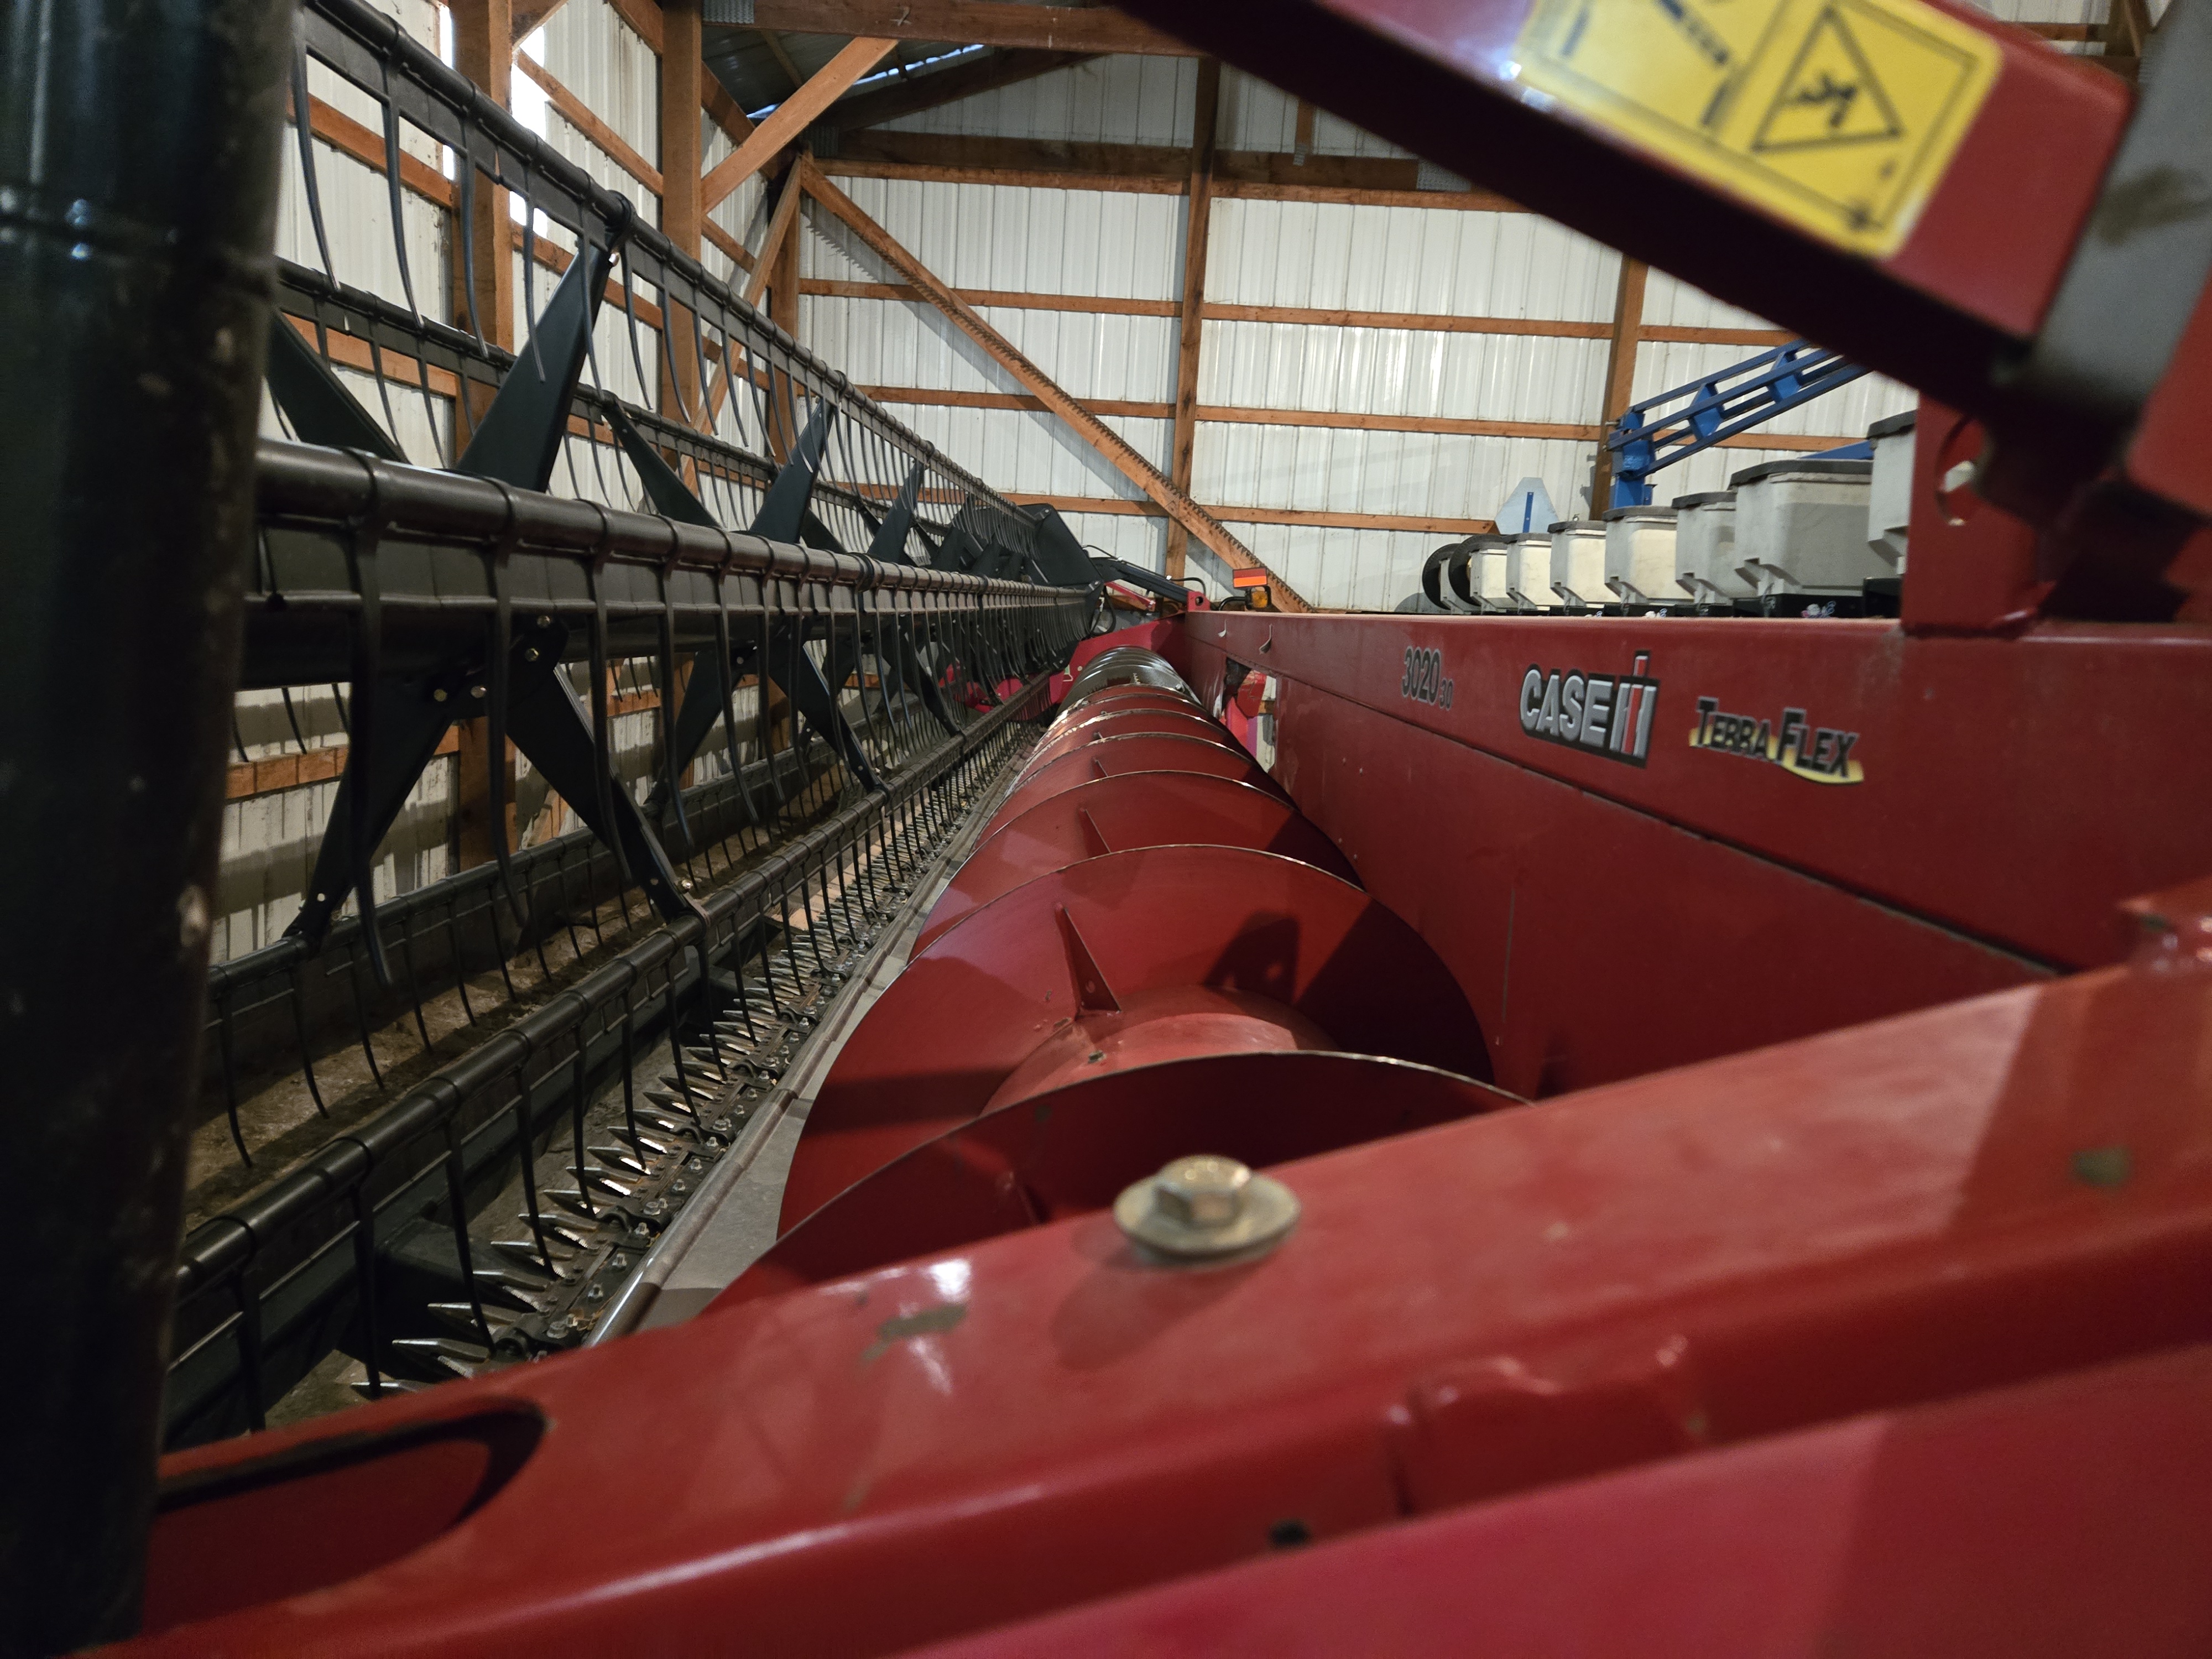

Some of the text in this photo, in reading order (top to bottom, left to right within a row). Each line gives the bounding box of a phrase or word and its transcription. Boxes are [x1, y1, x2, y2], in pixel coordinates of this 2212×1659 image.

[1401, 645, 1453, 711] 3020 30
[1520, 666, 1614, 748] CASE
